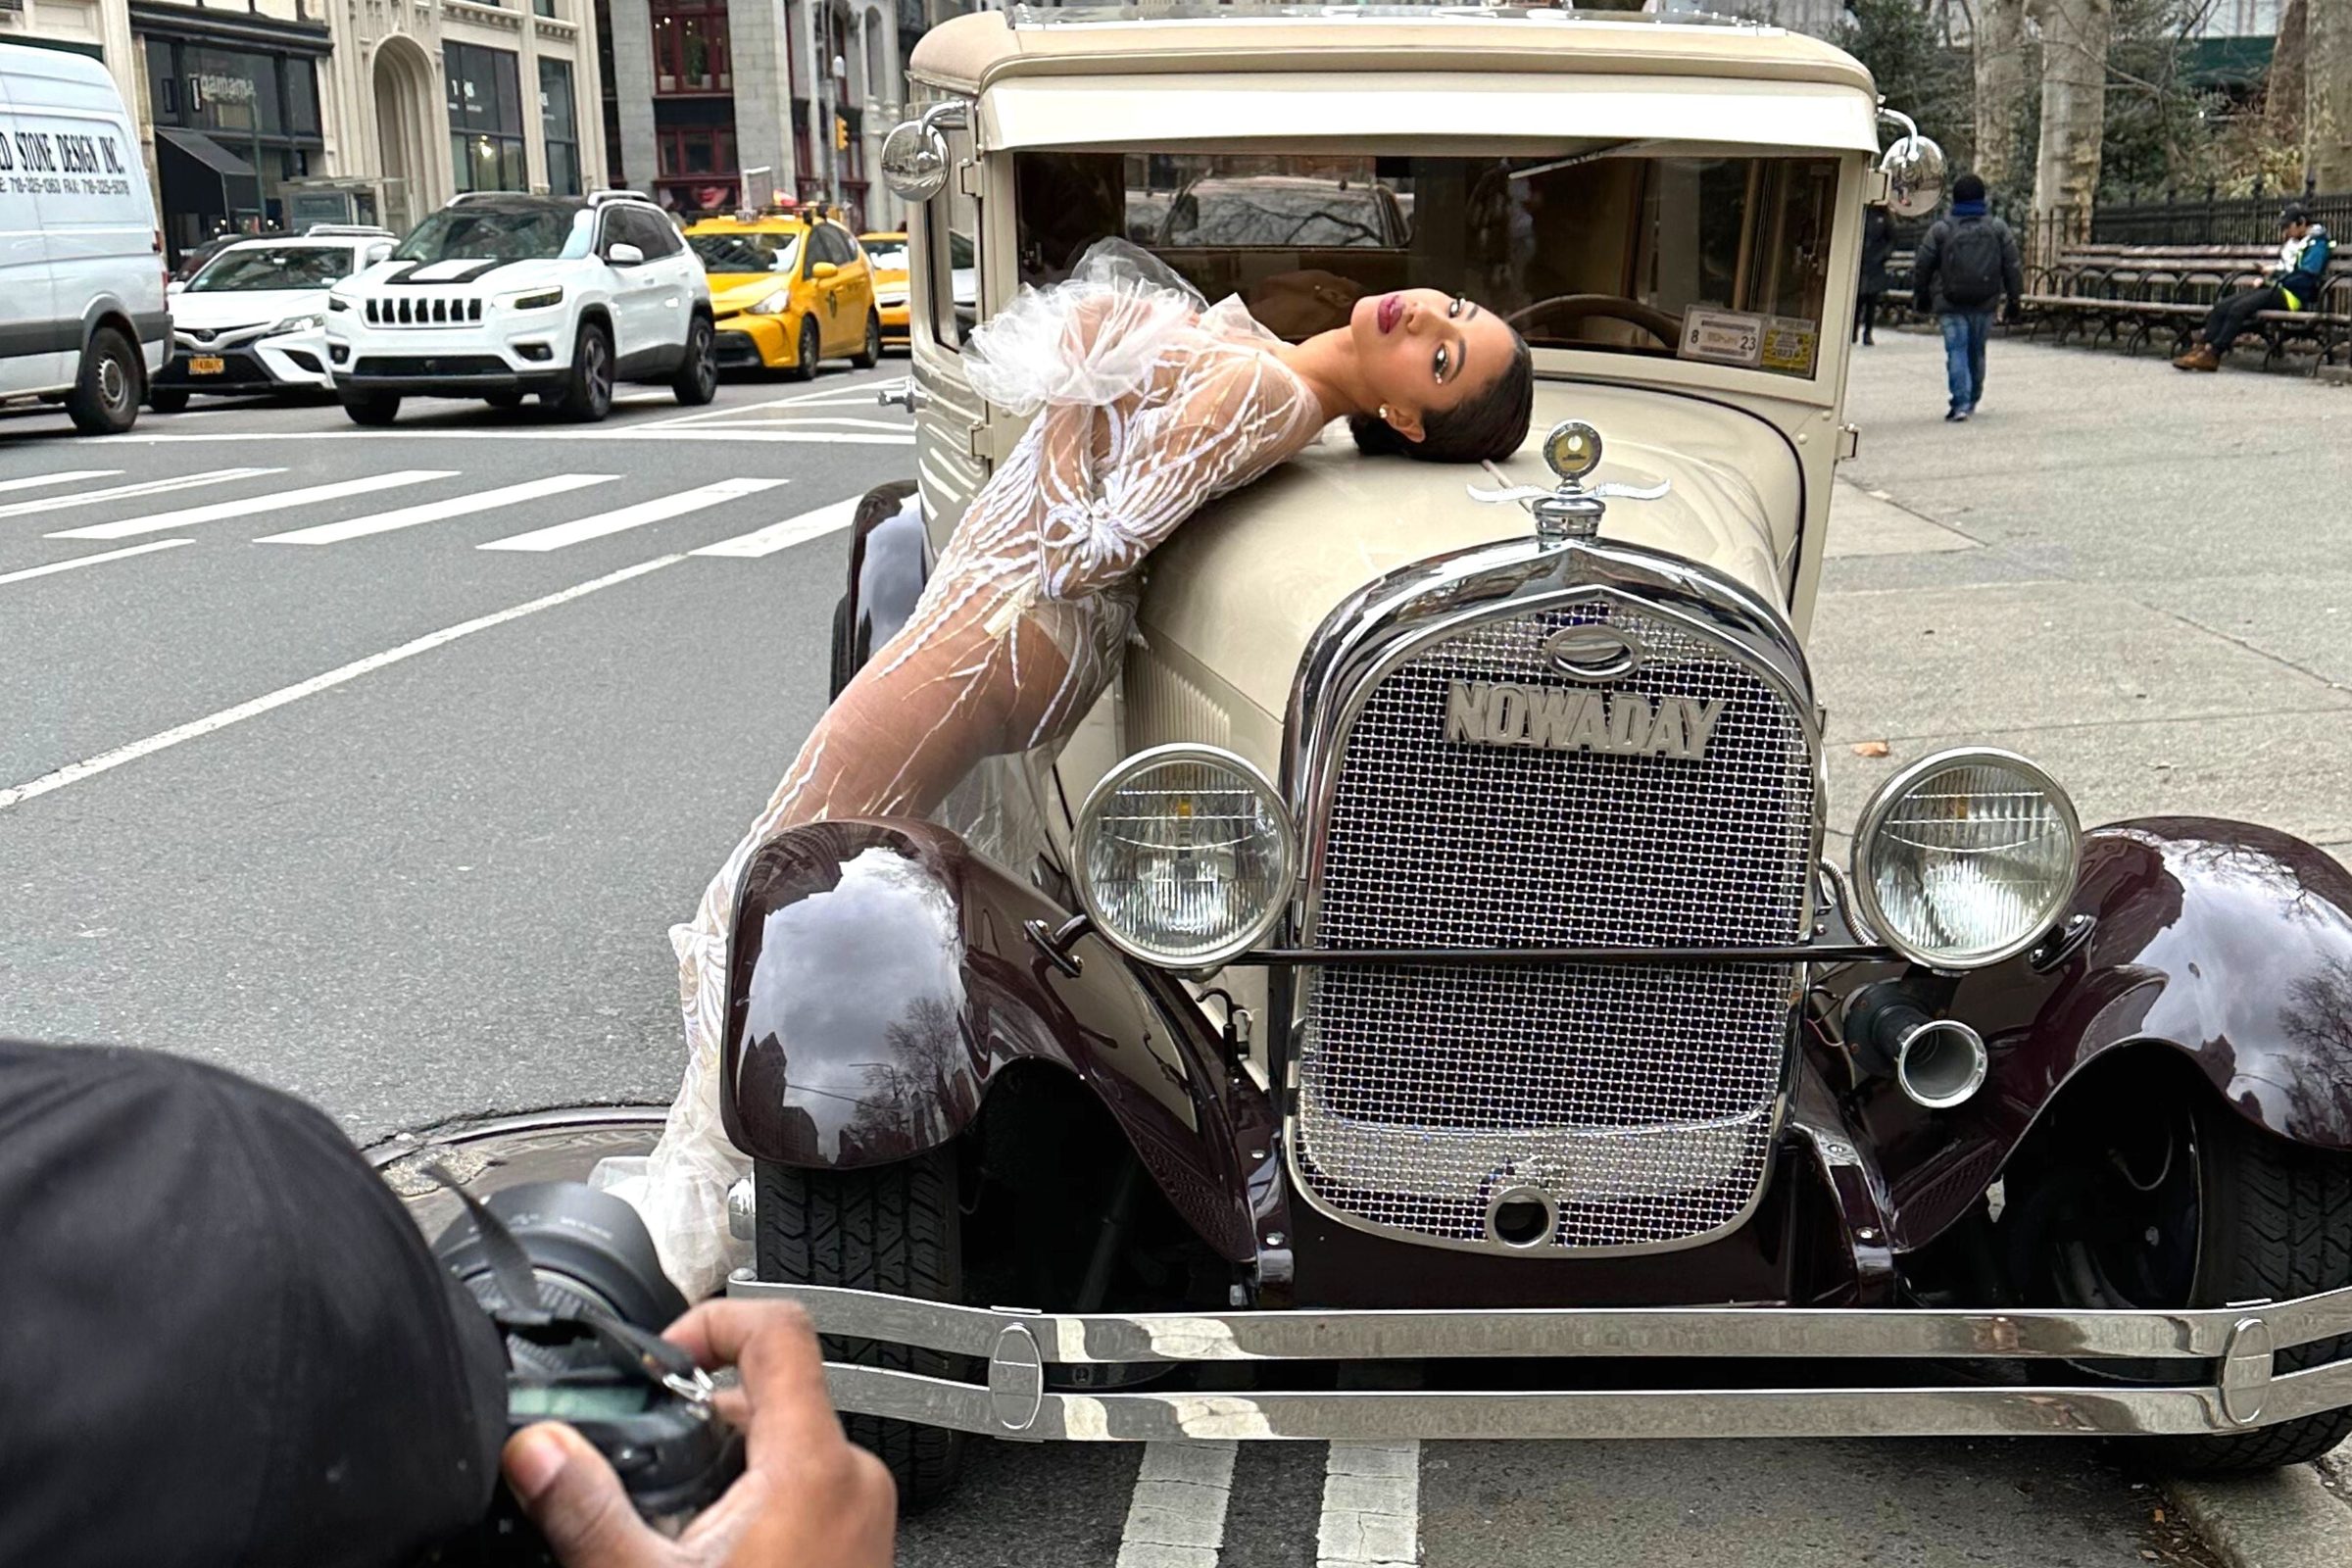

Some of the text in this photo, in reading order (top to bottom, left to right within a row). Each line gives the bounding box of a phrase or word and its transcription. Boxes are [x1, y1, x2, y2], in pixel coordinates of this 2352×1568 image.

[15, 131, 56, 172] STONE
[56, 133, 99, 173] DESIGN
[98, 136, 125, 174] INC.
[1690, 329, 1700, 344] 8
[1740, 335, 1757, 352] 23
[1446, 678, 1726, 760] NOWADAY
